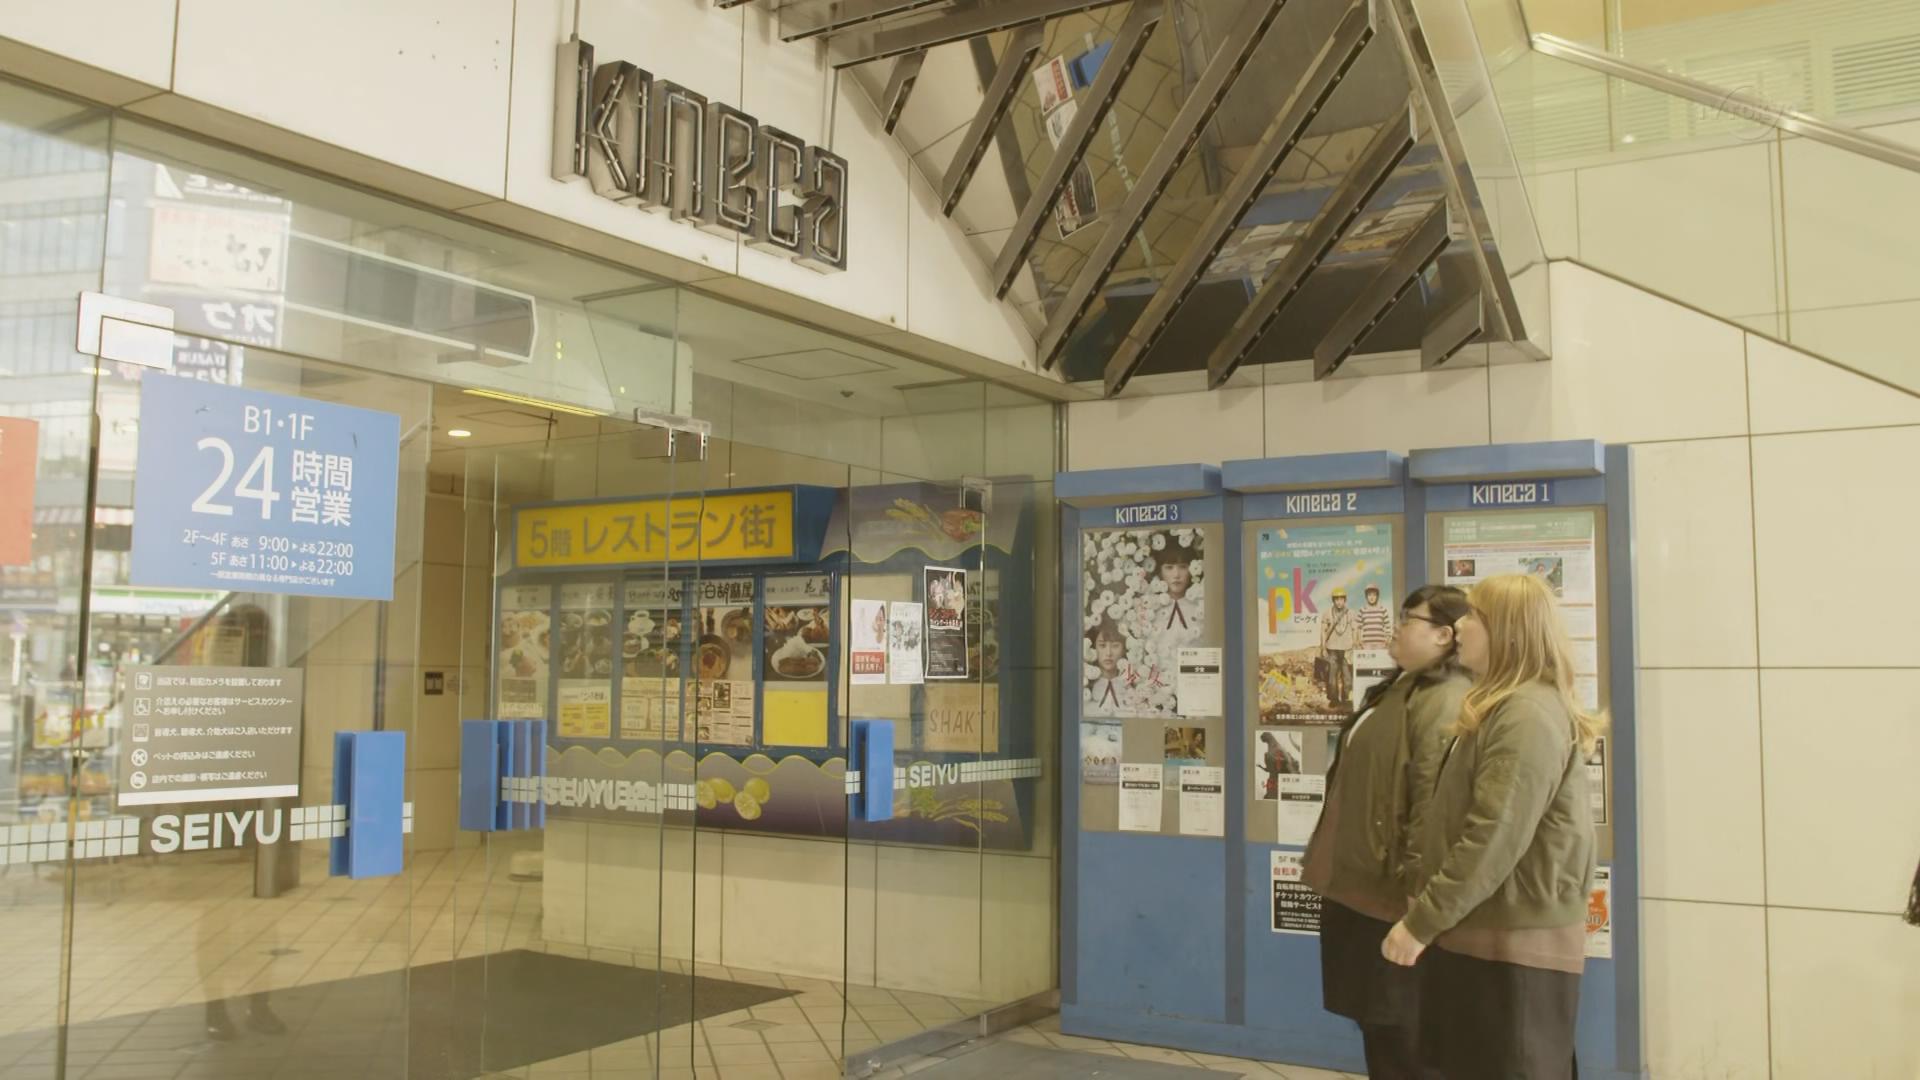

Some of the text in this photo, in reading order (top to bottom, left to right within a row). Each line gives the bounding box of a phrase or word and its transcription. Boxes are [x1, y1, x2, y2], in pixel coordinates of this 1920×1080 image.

[191, 437, 353, 520] 24 時間
[1347, 493, 1357, 511] 2
[1541, 483, 1550, 502] 1
[291, 486, 352, 527] 営業
[1170, 504, 1178, 521] 3
[583, 504, 777, 556] レストラン街
[258, 535, 289, 553] 9:00
[210, 551, 226, 566] 5F
[1268, 567, 1318, 634] pk
[909, 763, 958, 788] SEIYU
[151, 808, 282, 853] SEIYU
